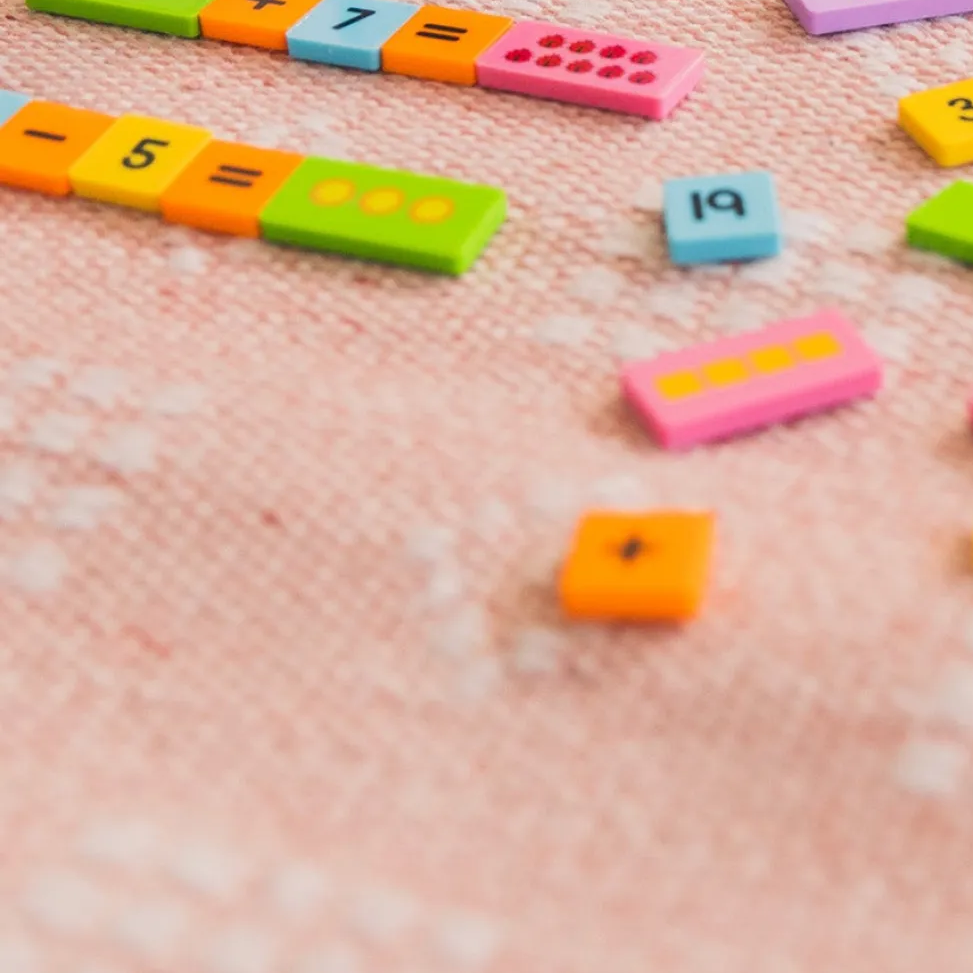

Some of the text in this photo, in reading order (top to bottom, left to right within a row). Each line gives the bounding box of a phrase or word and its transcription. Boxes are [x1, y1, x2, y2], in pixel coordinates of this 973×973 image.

[331, 6, 377, 30] 7
[121, 137, 170, 169] 5
[691, 188, 745, 221] 19
